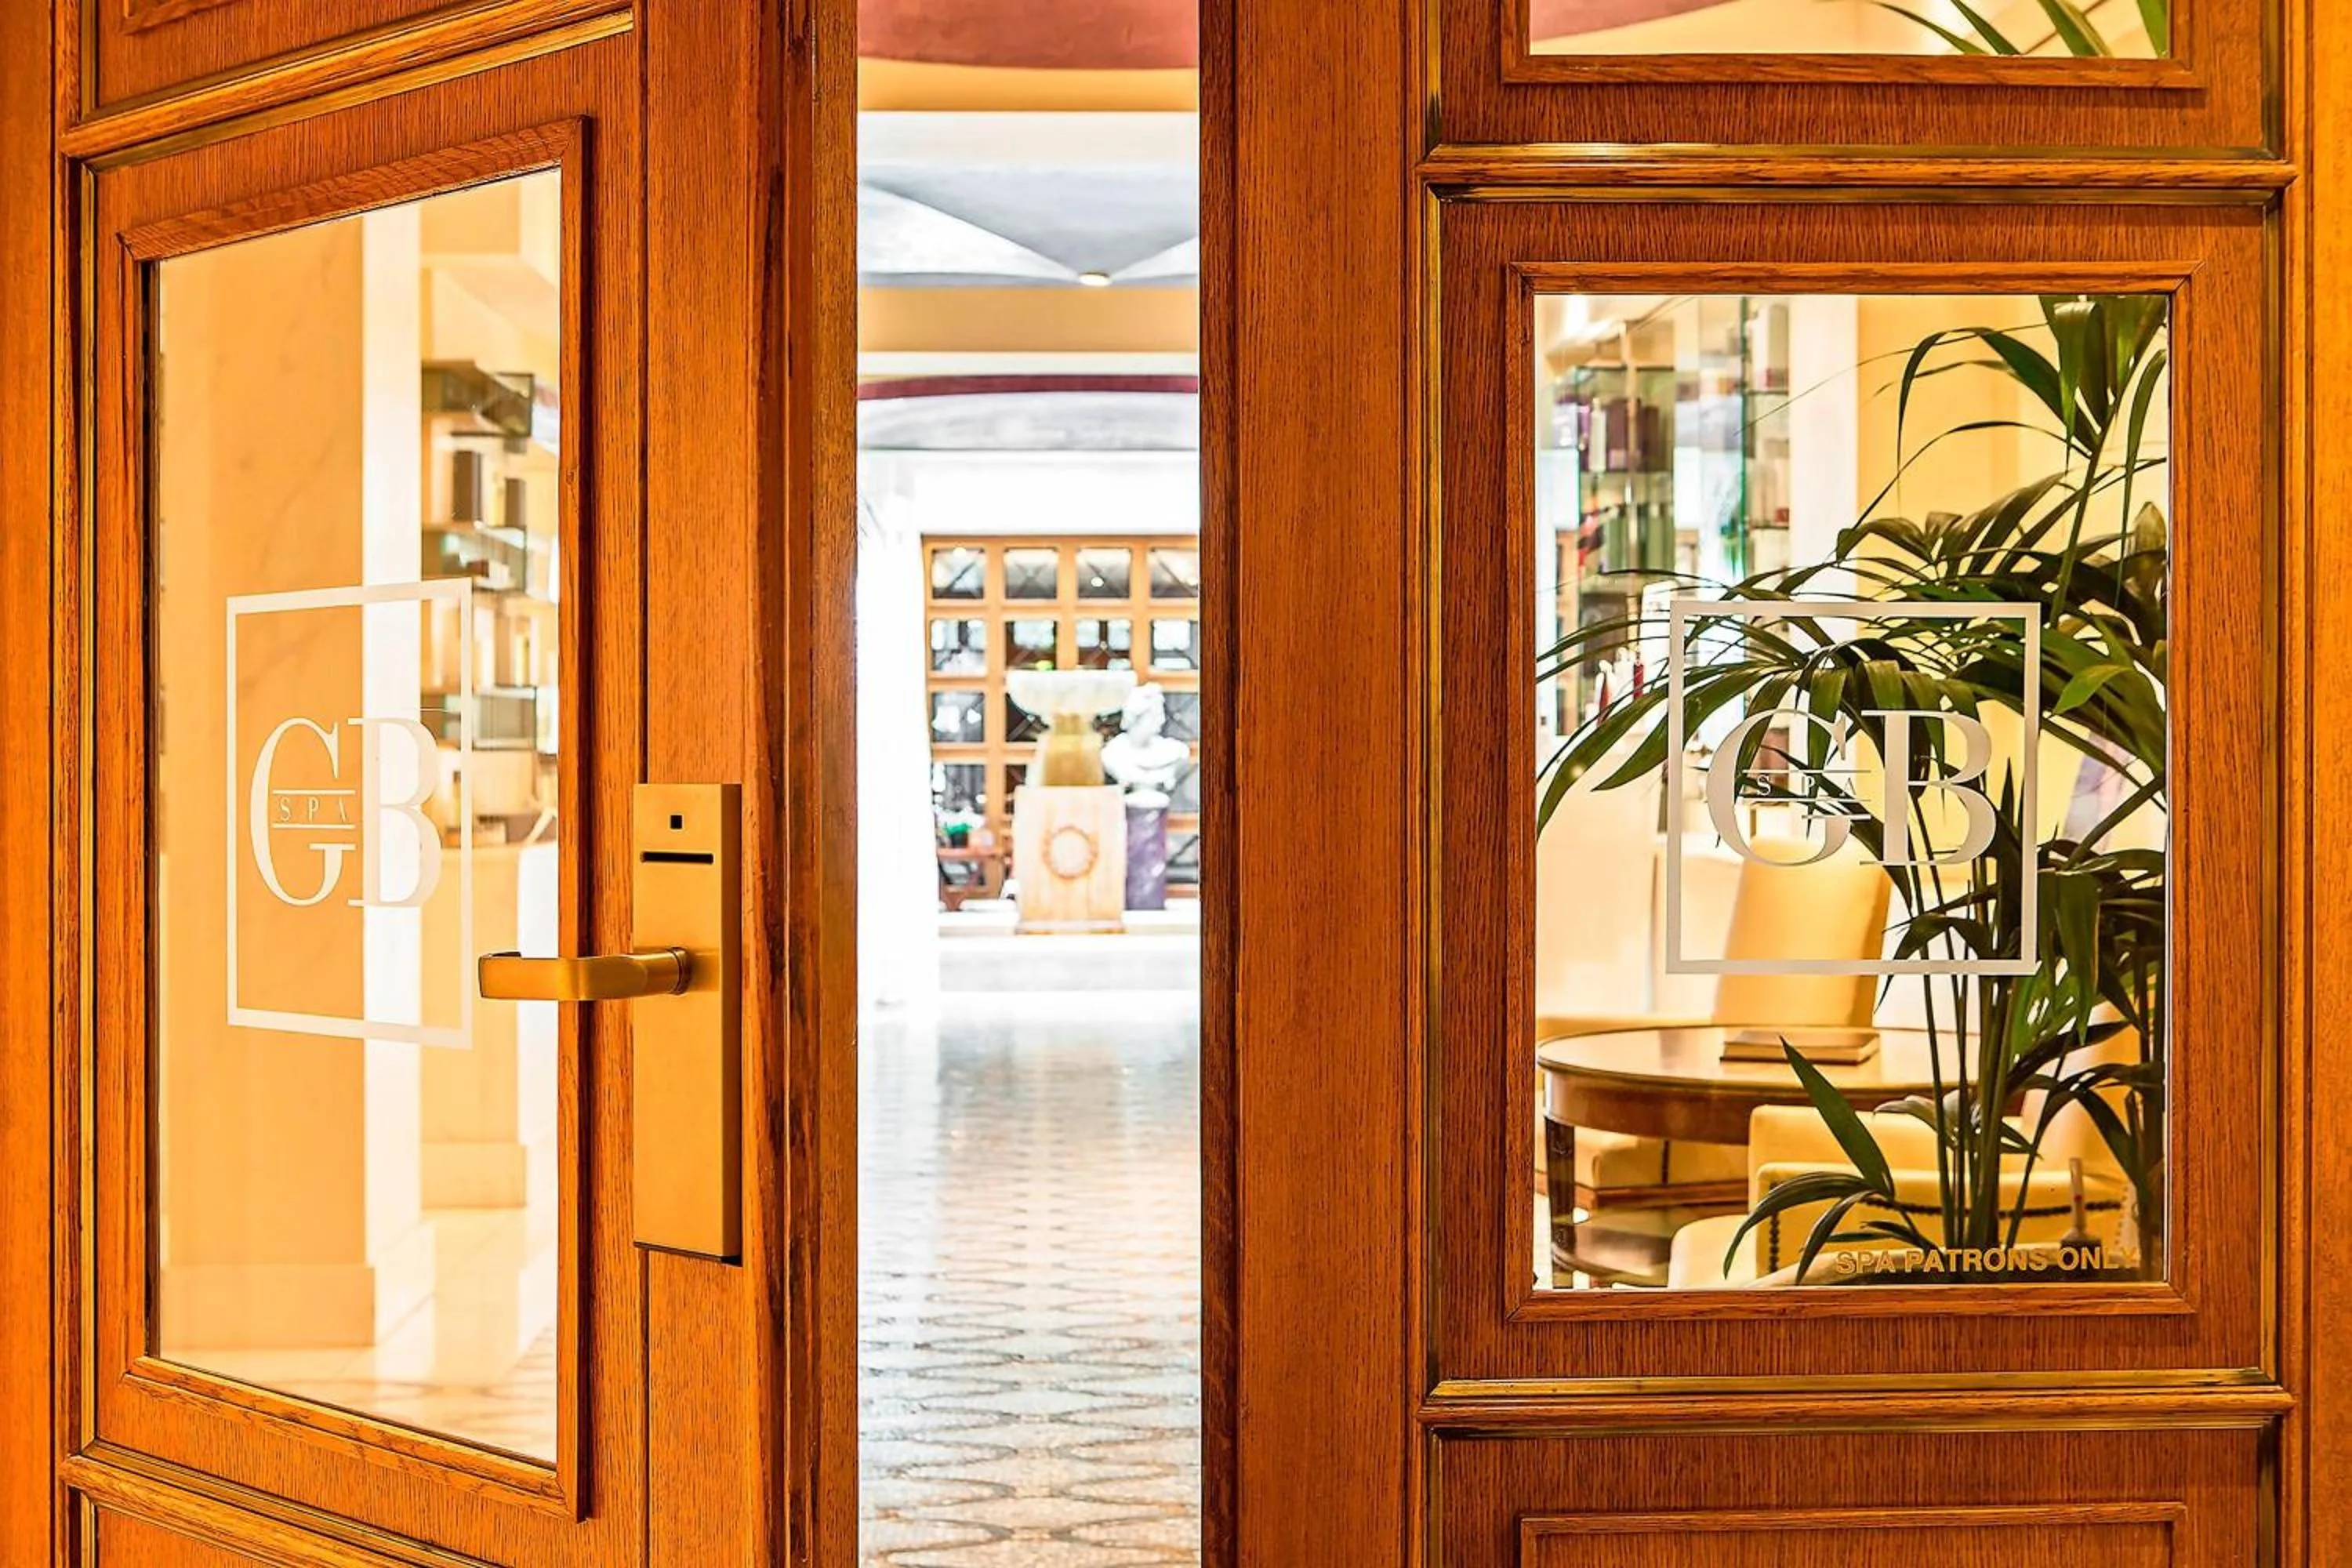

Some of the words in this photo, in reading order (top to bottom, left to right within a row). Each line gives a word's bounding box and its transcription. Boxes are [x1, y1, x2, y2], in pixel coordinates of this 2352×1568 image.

[1706, 709, 1997, 866] GB
[1756, 774, 1857, 797] SPA
[250, 717, 441, 908] GB
[278, 795, 348, 823] SPA
[1835, 1251, 1896, 1274] SPA
[1905, 1248, 2046, 1272] PATRONS
